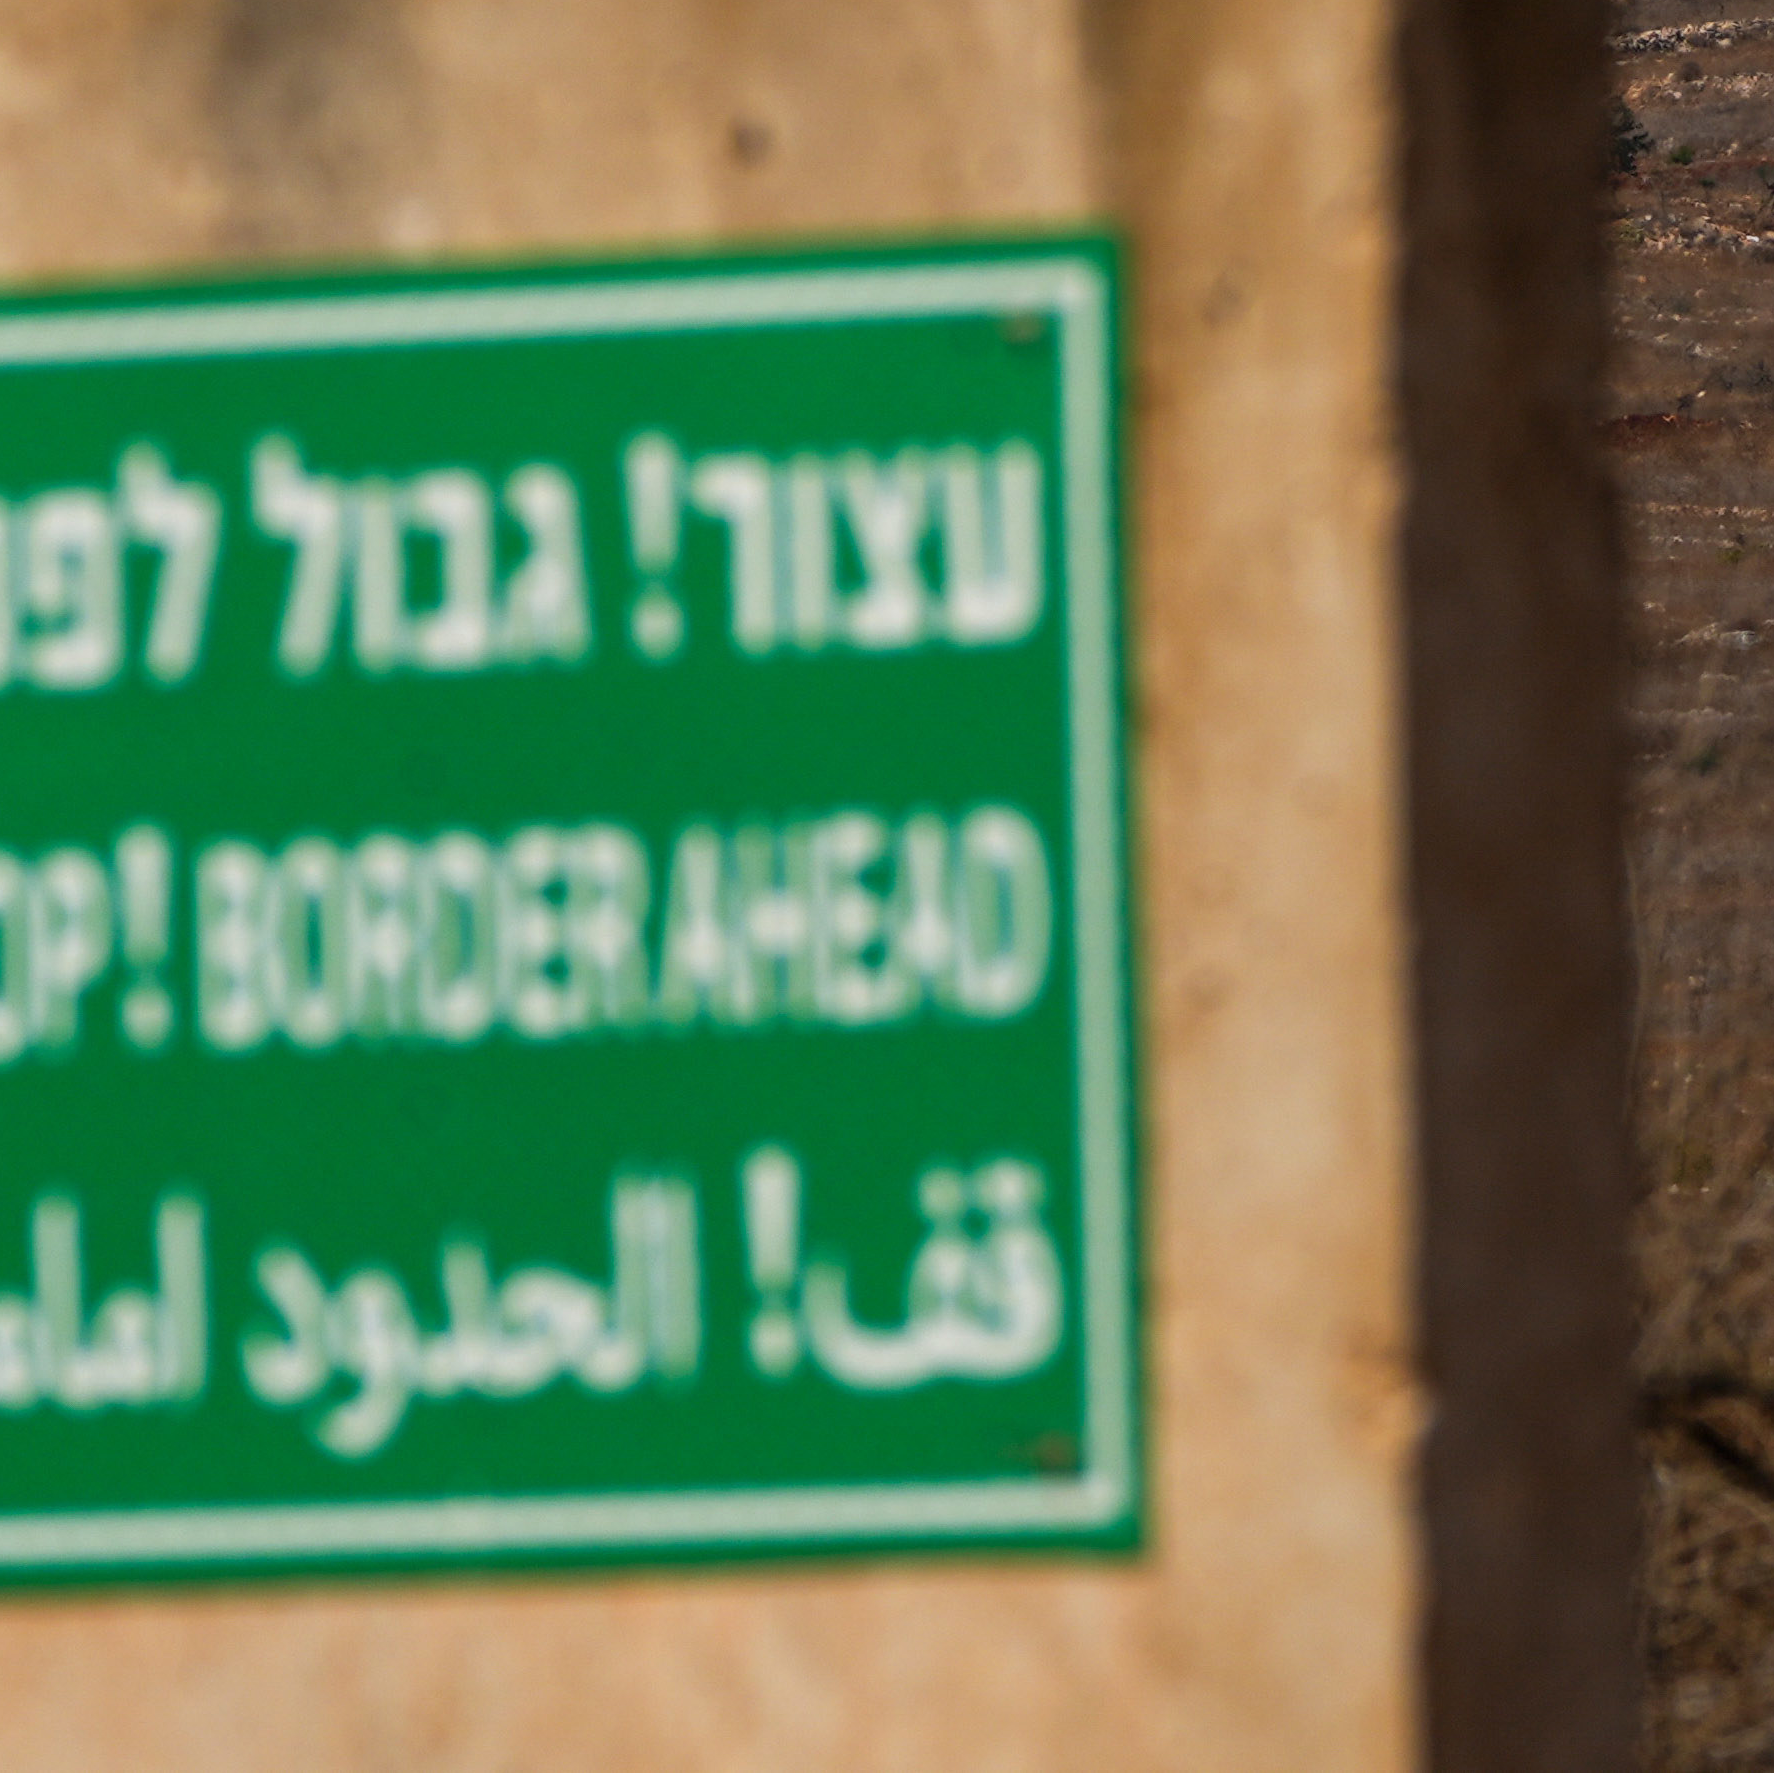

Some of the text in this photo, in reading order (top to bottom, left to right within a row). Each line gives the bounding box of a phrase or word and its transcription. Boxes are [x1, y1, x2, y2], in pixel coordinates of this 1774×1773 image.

[247, 430, 593, 676] גבול
[625, 430, 1047, 660] עצור!
[195, 824, 649, 1050] BORDER
[659, 804, 1055, 1030] AHEAD
[241, 1172, 701, 1458] الحدود
